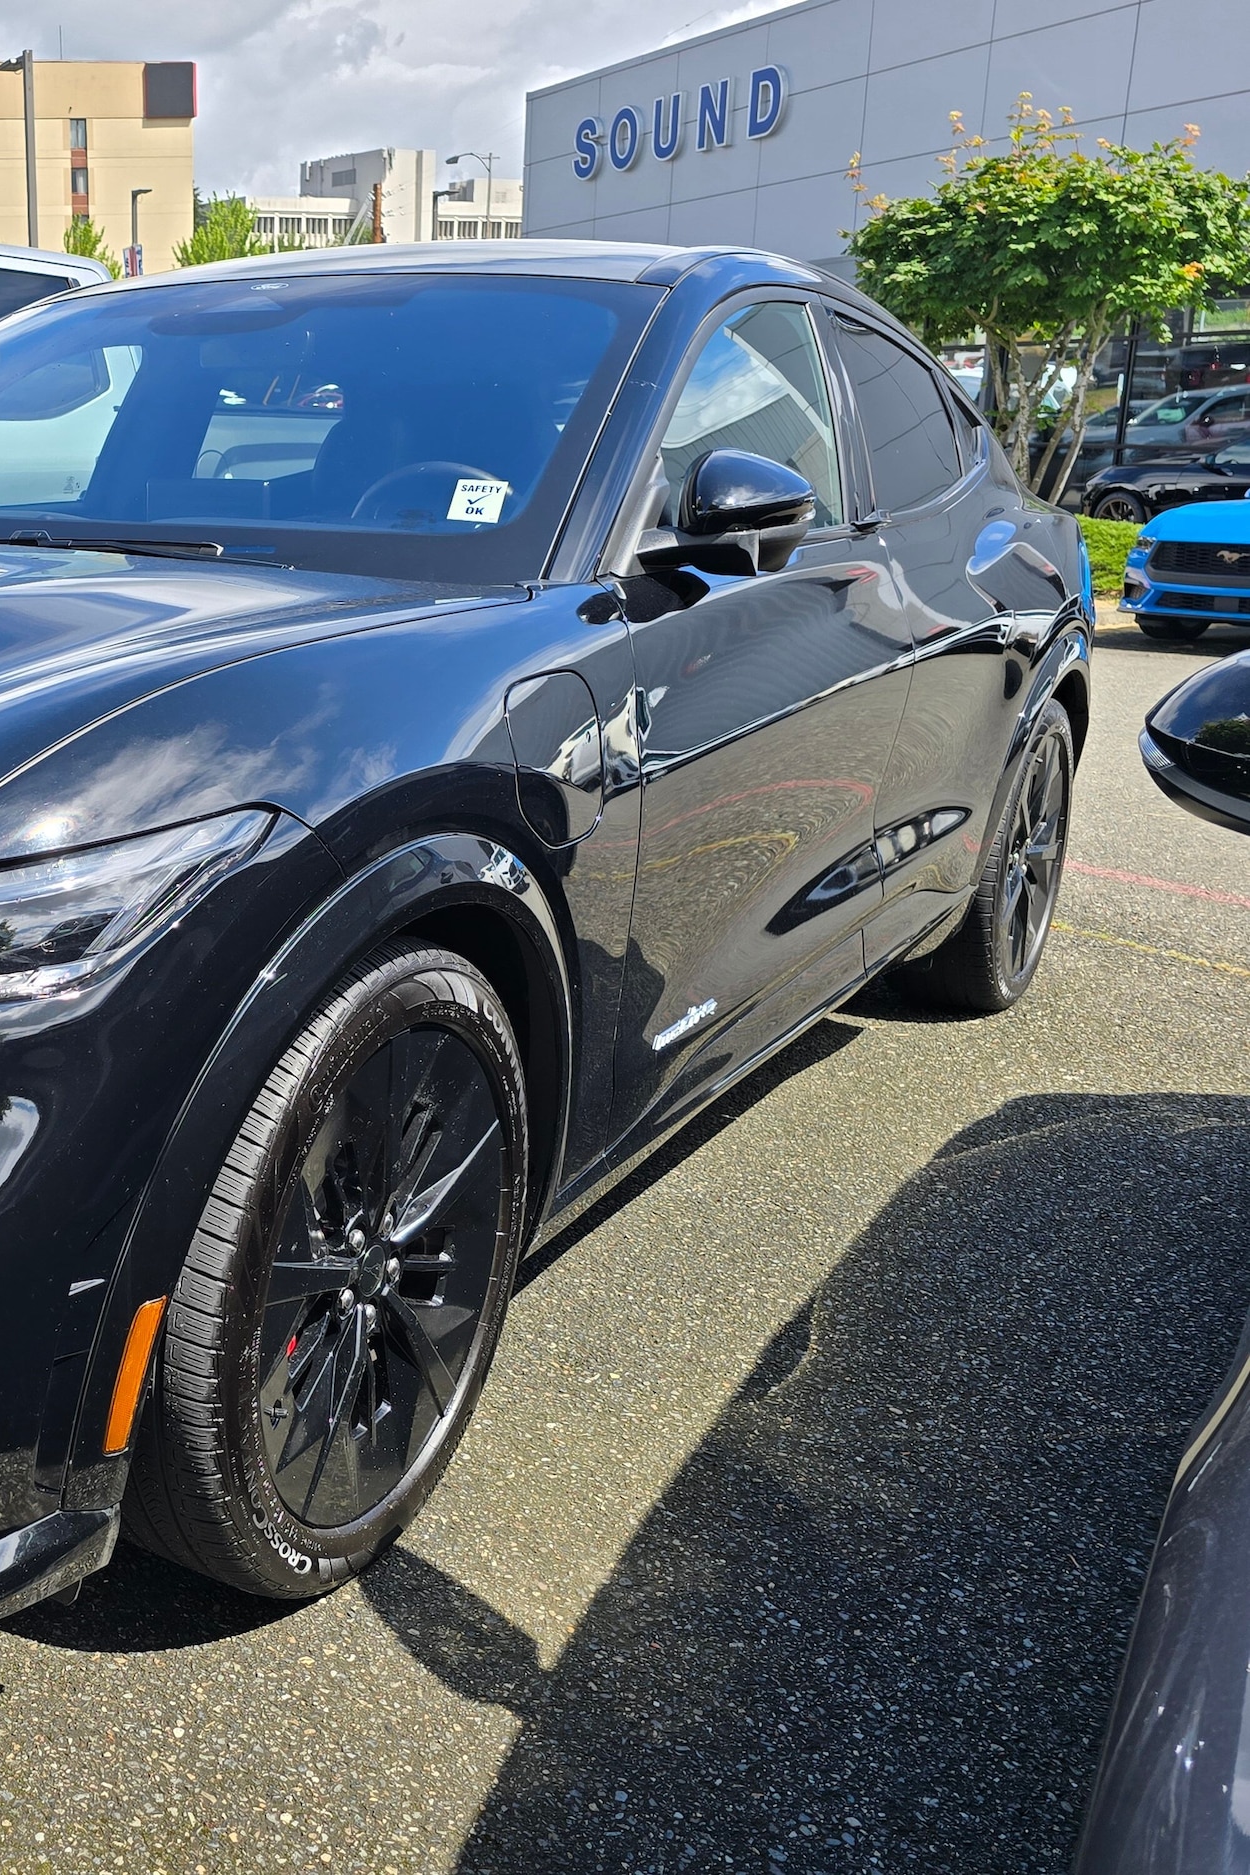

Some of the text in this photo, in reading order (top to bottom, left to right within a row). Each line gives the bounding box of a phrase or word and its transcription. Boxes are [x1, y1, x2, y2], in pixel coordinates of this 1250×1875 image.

[571, 64, 788, 181] SOUND
[460, 484, 502, 494] SAFETY
[465, 506, 485, 516] OK
